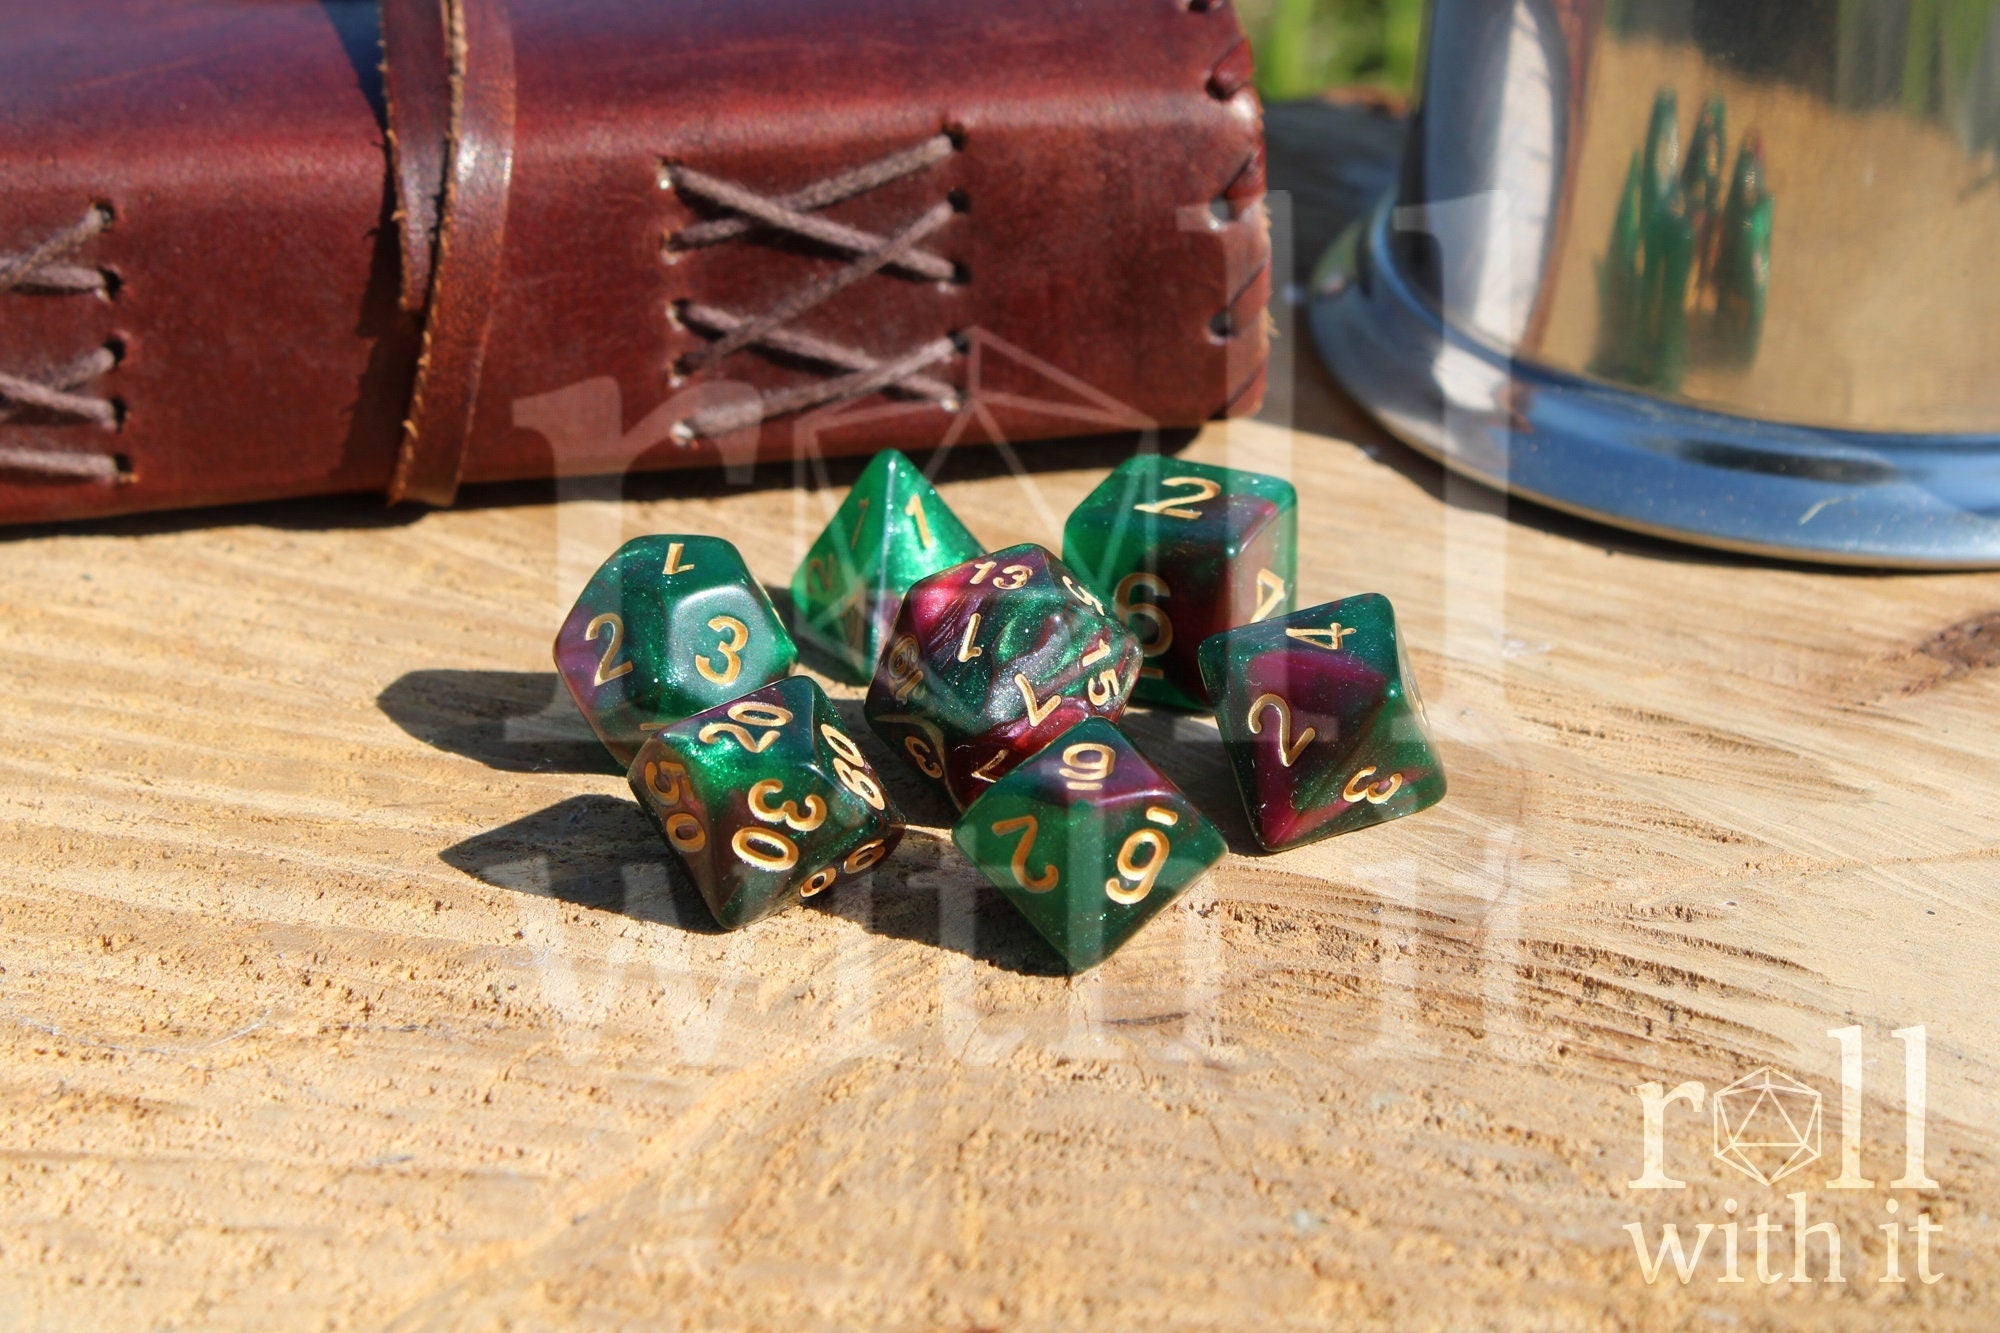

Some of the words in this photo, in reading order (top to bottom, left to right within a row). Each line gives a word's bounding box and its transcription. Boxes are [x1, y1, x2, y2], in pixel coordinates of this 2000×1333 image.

[905, 494, 932, 549] 1
[1134, 476, 1221, 520] 2
[662, 543, 694, 575] 1
[970, 561, 1033, 589] 13
[584, 612, 634, 687] 2
[695, 615, 748, 686] 3
[957, 613, 982, 662] 1
[1286, 622, 1356, 650] 4
[1082, 638, 1119, 706] 15
[1014, 673, 1062, 727] 7
[699, 701, 793, 754] 20
[1248, 693, 1316, 767] 2
[820, 723, 885, 810] 80
[904, 736, 943, 779] 3
[645, 761, 706, 851] 50
[1343, 766, 1402, 804] 3
[731, 779, 827, 872] 30
